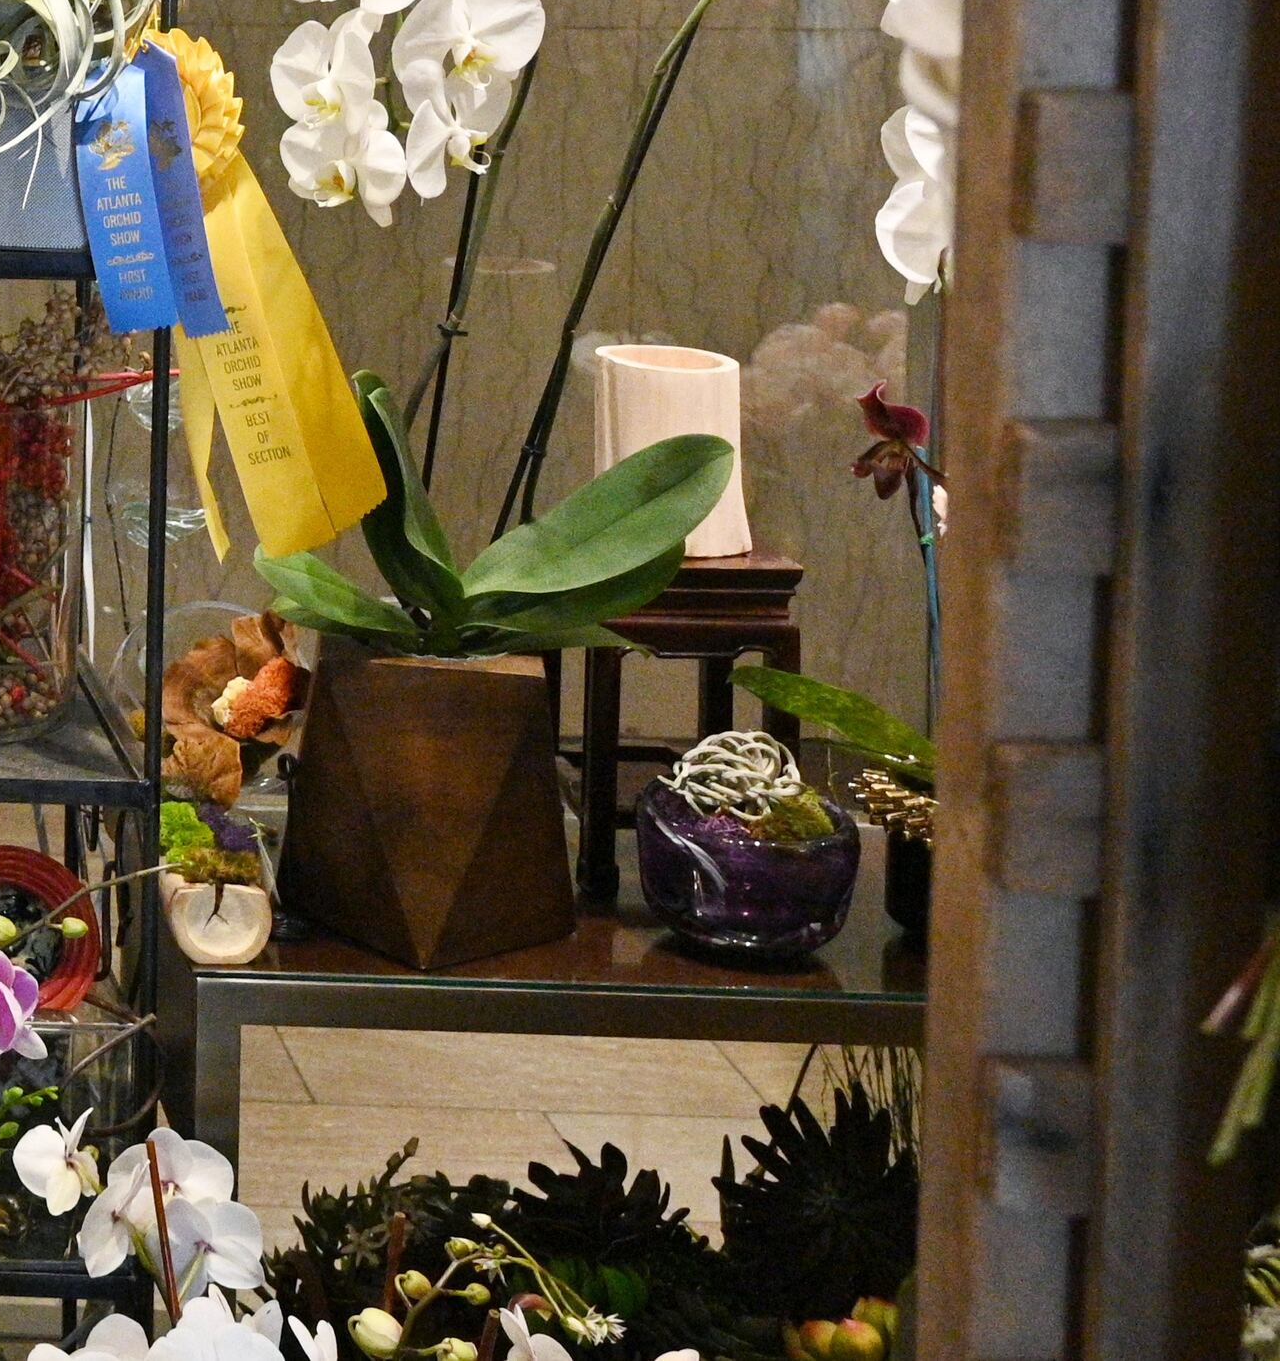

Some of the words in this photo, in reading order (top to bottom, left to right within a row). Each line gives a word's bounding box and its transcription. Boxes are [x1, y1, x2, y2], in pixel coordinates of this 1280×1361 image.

[105, 175, 127, 191] THE
[96, 193, 142, 211] ATLANTA
[103, 211, 142, 228] ORCHID
[110, 230, 142, 246] SHOW
[118, 269, 146, 284] FIRST
[215, 336, 260, 358] ATLANTA
[223, 355, 261, 374] ORCHID
[232, 373, 262, 391] SHOW
[245, 411, 271, 428] BEST
[256, 430, 269, 444] OF
[248, 445, 292, 465] SECTION
